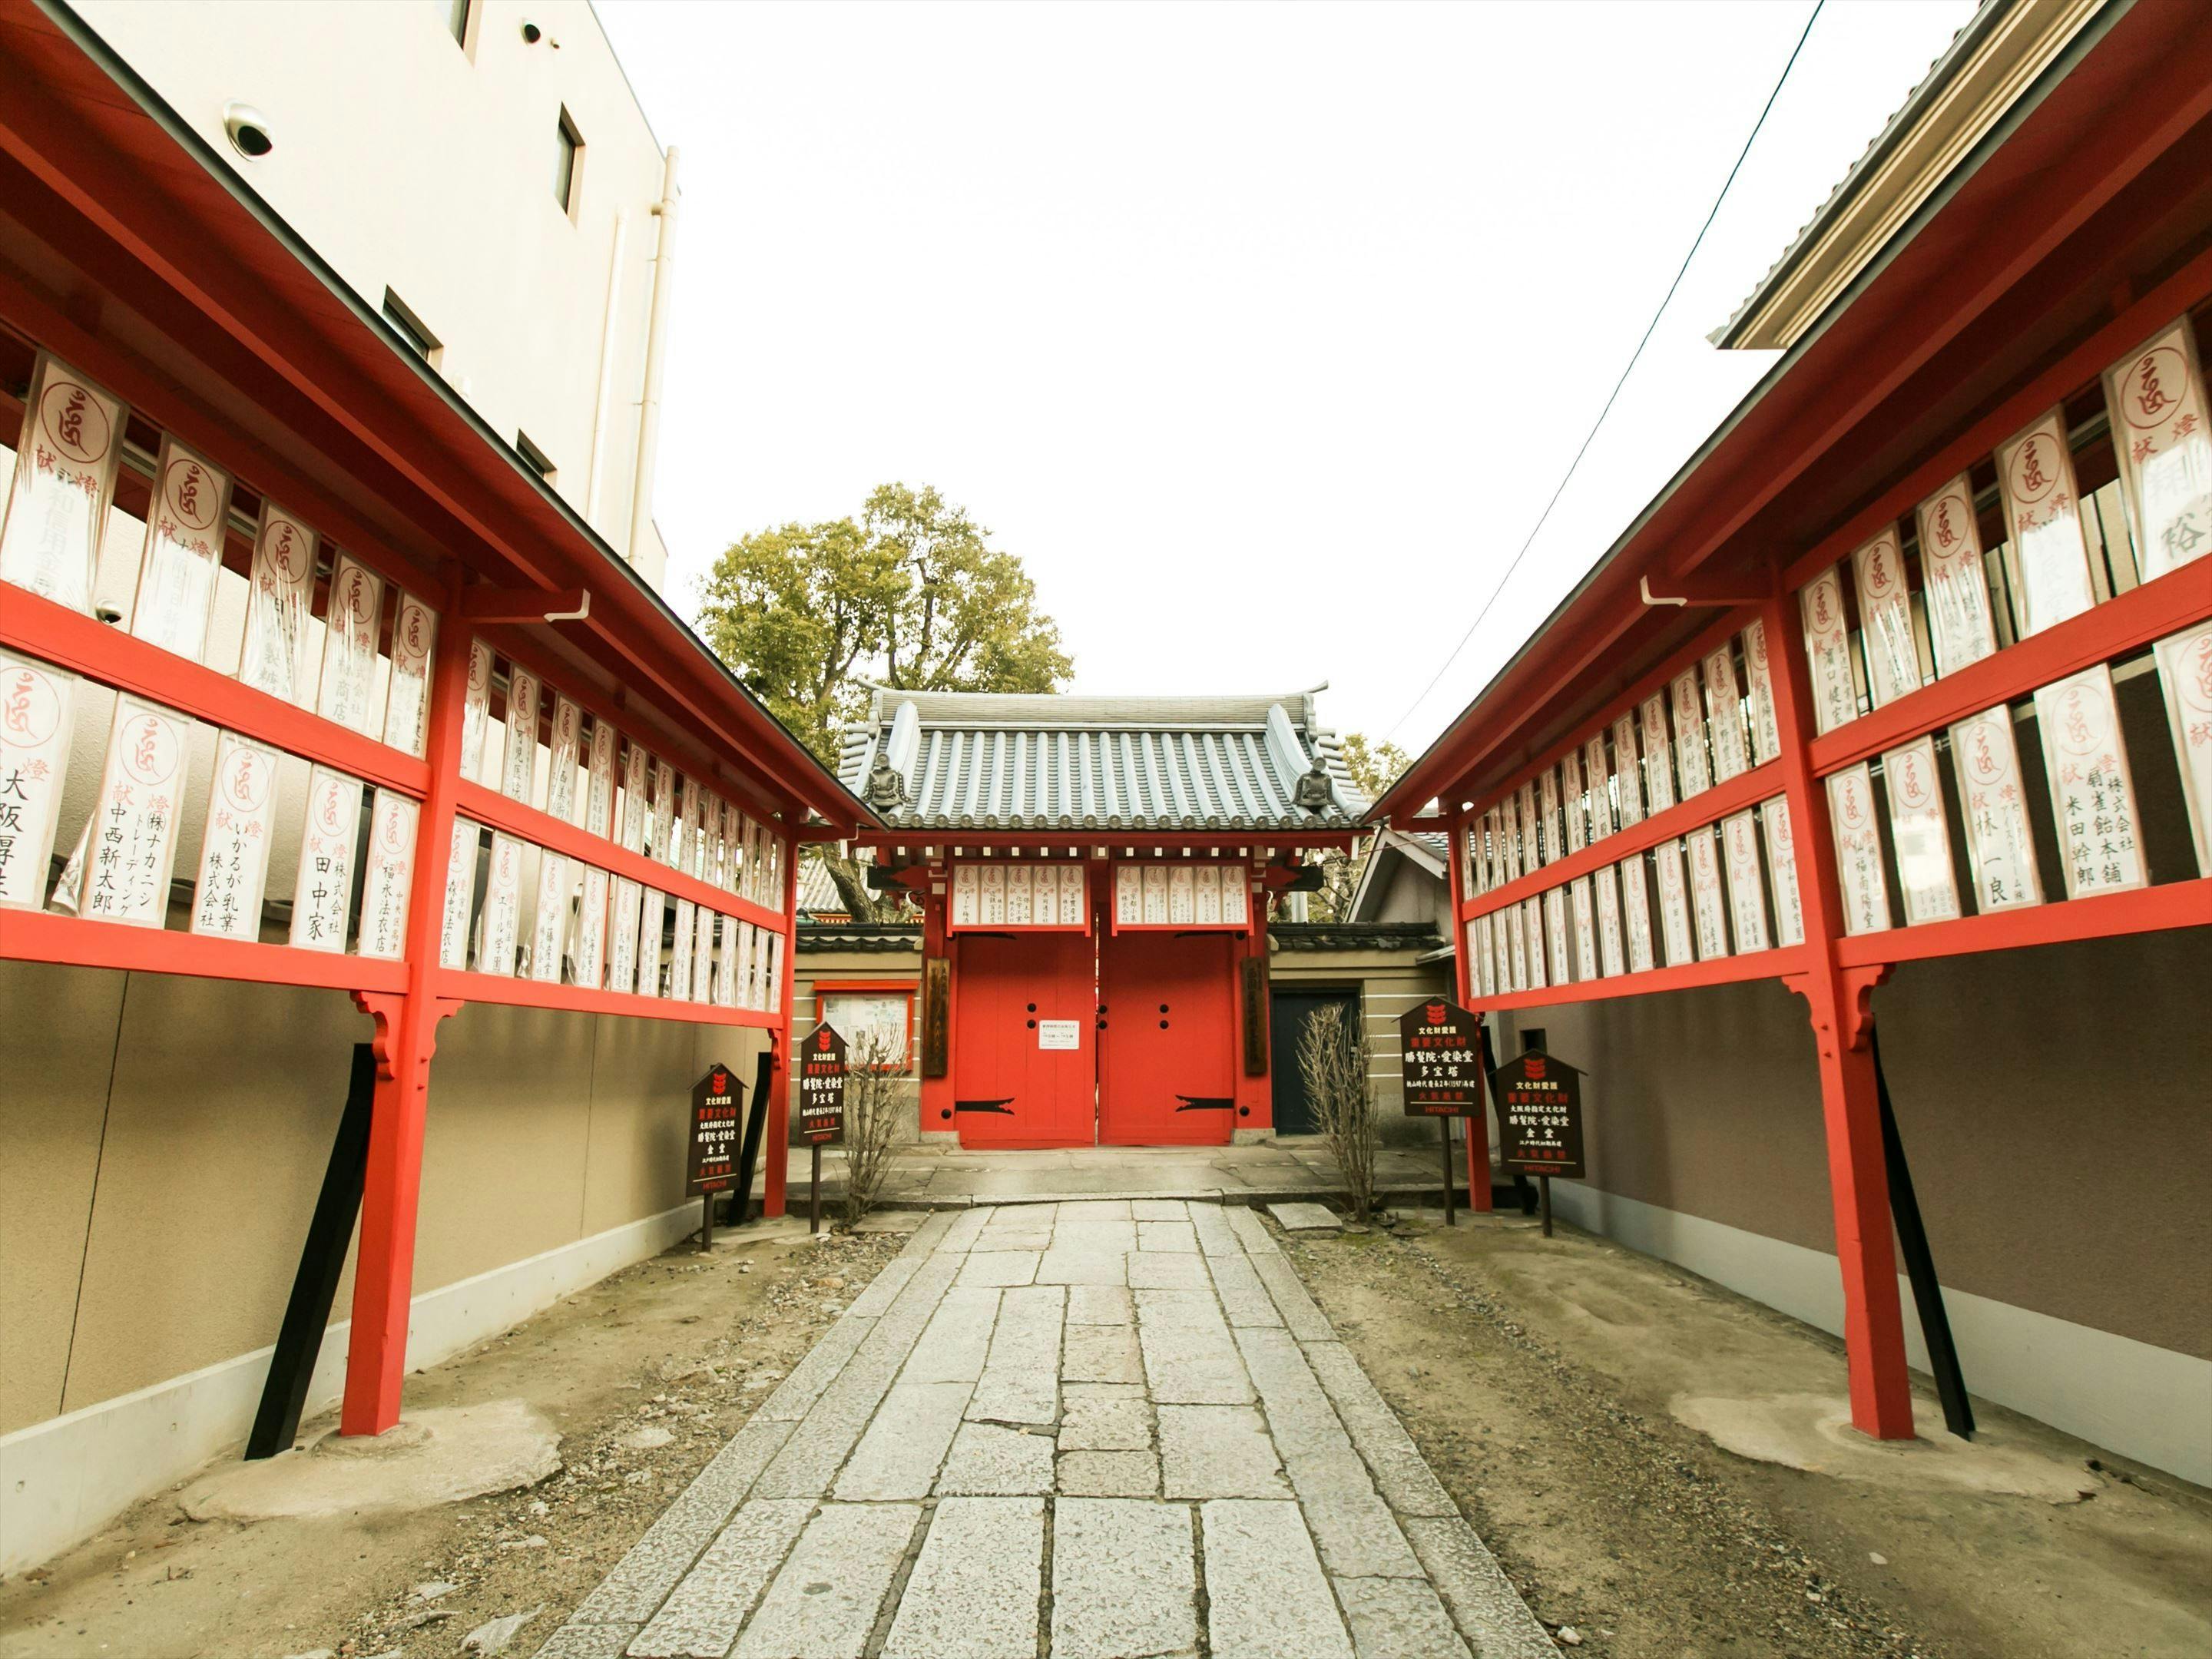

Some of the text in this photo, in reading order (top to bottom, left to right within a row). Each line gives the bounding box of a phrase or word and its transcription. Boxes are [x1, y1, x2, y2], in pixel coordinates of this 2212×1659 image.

[2065, 795, 2094, 886] 米田幹郎
[2087, 767, 2122, 883] 扇雀飴本舗
[2108, 776, 2135, 853] 株式会社
[92, 802, 127, 915] 中西新太郎
[200, 852, 223, 926] 株式会社
[219, 823, 247, 932] いかるが乳業
[1975, 810, 2008, 904] 林一良
[308, 856, 331, 941] 田中家
[329, 862, 346, 934] 株式会社
[375, 862, 395, 952] 福永法衣店
[494, 896, 507, 972] エール学園
[1410, 1037, 1466, 1048] 重要文化財
[1419, 1026, 1456, 1035] 文化財愛護
[812, 1092, 834, 1104] 多宝塔
[1421, 1065, 1458, 1078] 多宝塔
[1516, 1081, 1558, 1090] 文化財愛護
[1510, 1105, 1567, 1114] 大阪府指定文化財
[1523, 1164, 1561, 1174] HITACHI
